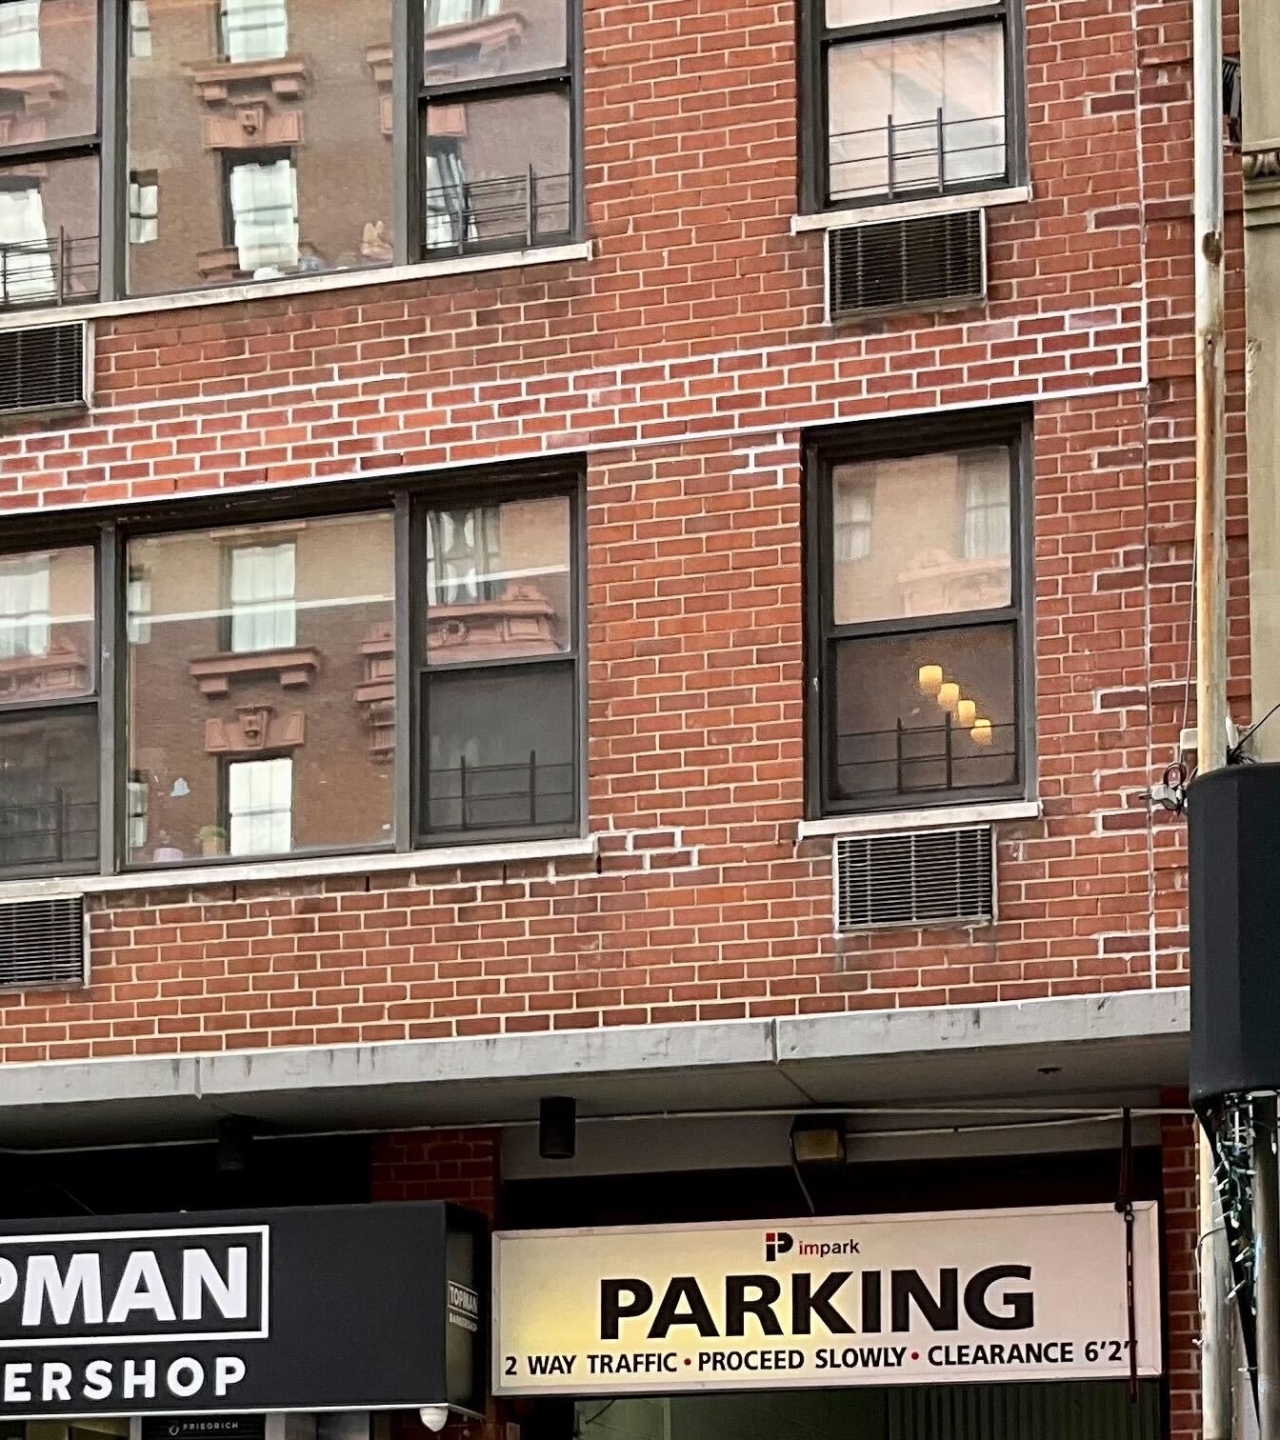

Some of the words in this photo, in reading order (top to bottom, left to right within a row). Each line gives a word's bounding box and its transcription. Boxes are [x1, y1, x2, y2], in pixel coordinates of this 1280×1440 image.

[799, 1239, 860, 1257] impark
[599, 1264, 1034, 1340] PARKING
[505, 1356, 517, 1375] 2
[528, 1355, 577, 1375] WAY
[587, 1352, 678, 1374] TRAFFIC
[698, 1349, 805, 1371] PROCEED
[815, 1347, 907, 1369] SLOWLY
[927, 1342, 1074, 1366] CLEARANCE
